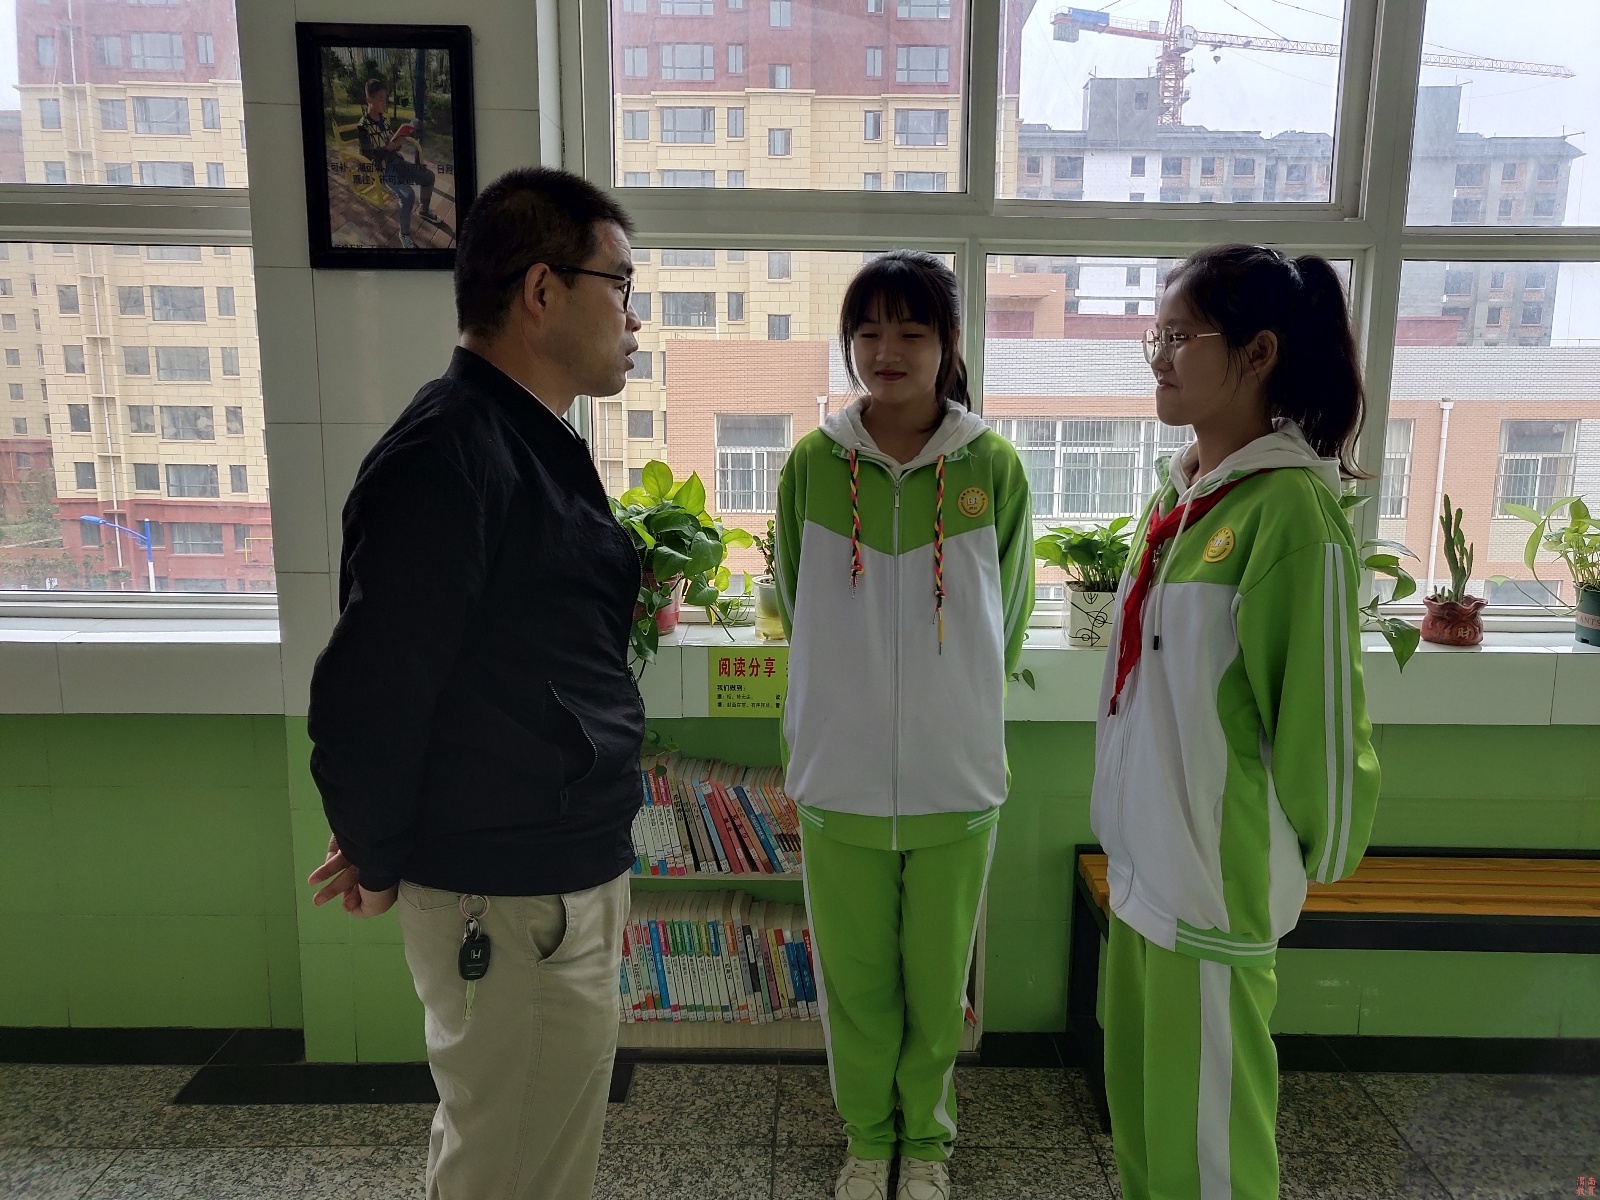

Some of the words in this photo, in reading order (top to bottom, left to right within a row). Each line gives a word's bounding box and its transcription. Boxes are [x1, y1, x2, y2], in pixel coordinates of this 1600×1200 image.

[1457, 626, 1471, 640] 财
[718, 657, 776, 677] 阅读分享
